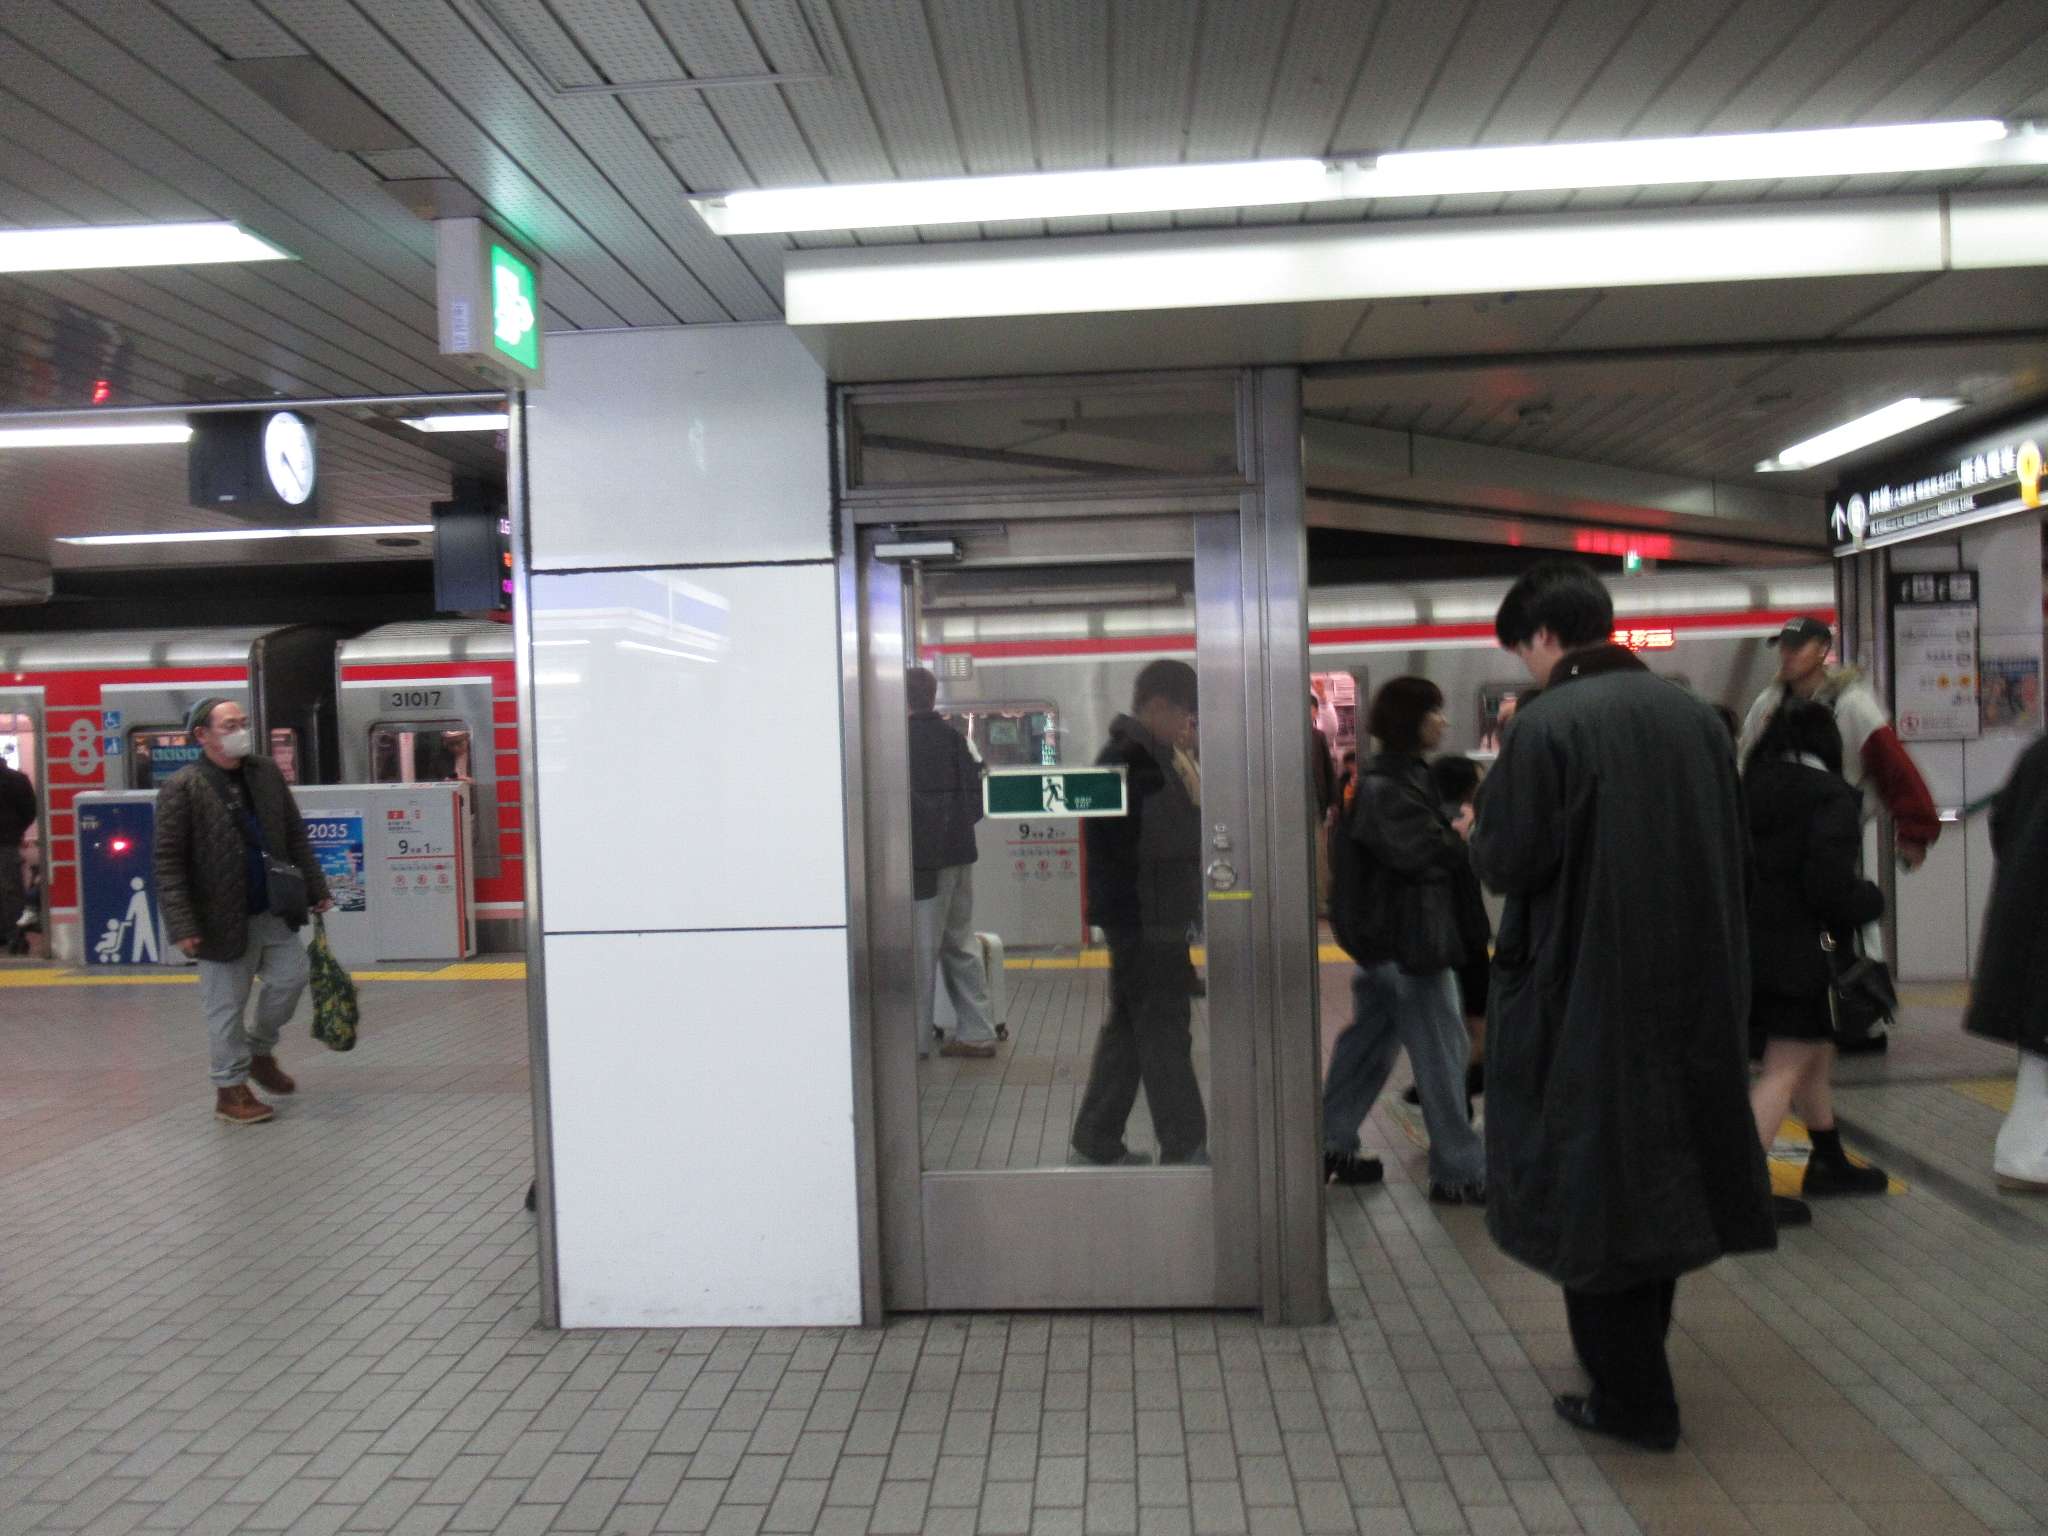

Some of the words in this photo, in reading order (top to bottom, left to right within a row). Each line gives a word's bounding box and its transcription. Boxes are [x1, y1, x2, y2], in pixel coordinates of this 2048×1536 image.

[392, 690, 441, 707] 31017
[70, 719, 98, 775] 8
[307, 823, 348, 839] 2035
[1019, 823, 1030, 839] 9
[398, 839, 409, 855] 9
